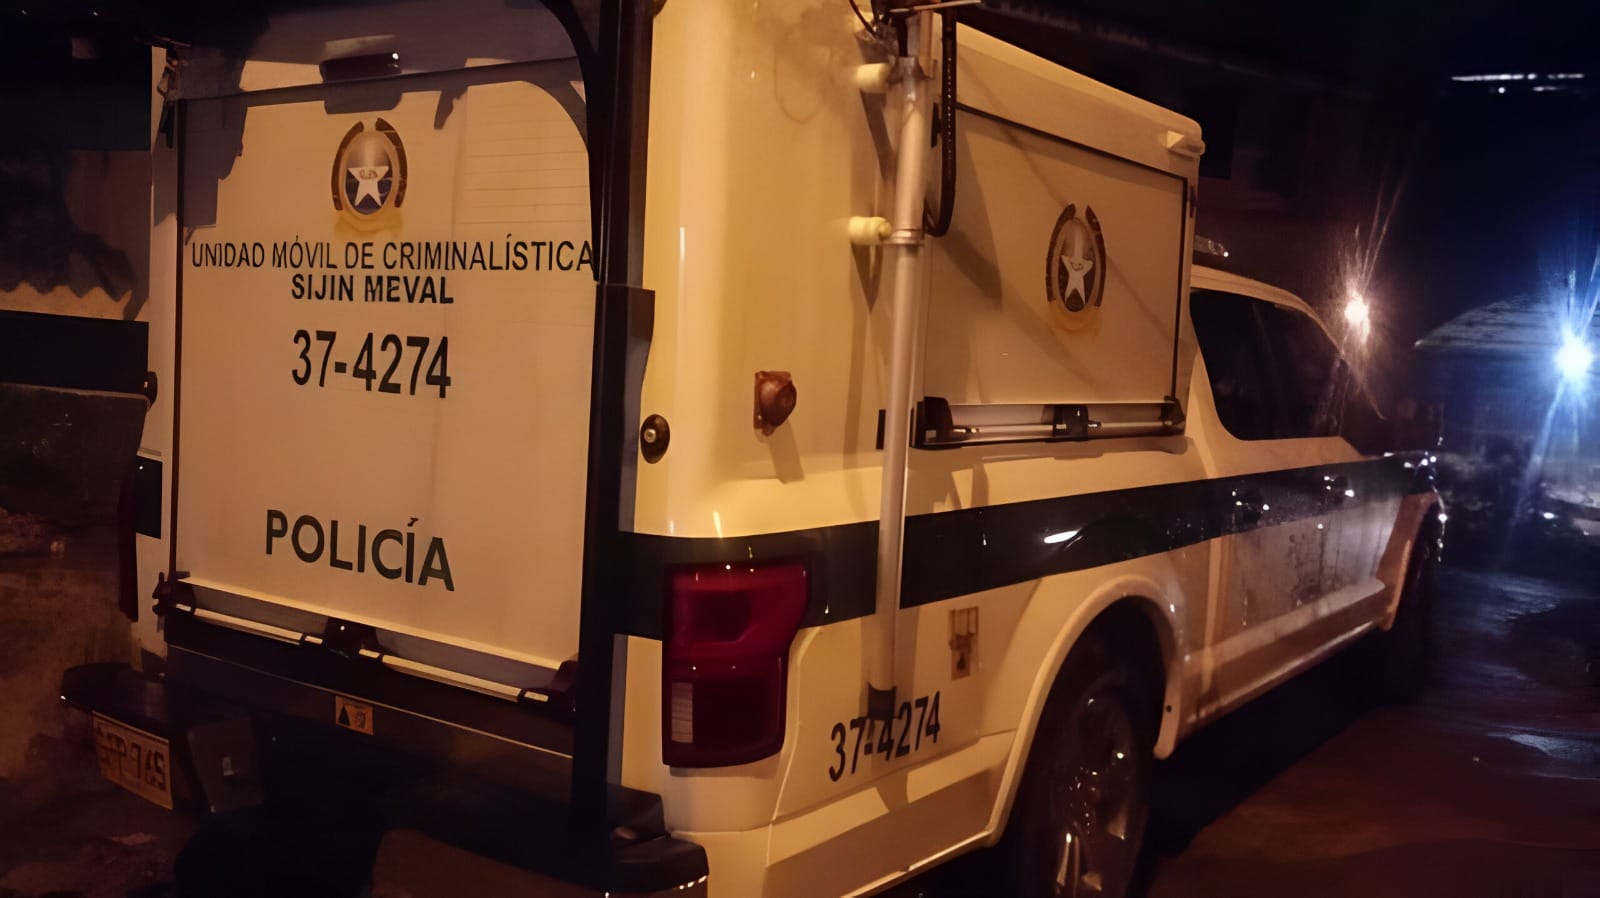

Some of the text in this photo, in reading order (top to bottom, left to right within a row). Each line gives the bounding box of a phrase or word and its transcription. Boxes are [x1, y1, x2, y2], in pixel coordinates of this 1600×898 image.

[192, 233, 594, 272] UNIDAD MÓVIL DE CRIMINALÍSTICA
[291, 273, 454, 304] SIJIN MEVAL
[292, 329, 452, 399] 37-4274
[265, 509, 455, 592] POLICÍA
[829, 691, 941, 783] 37-4274
